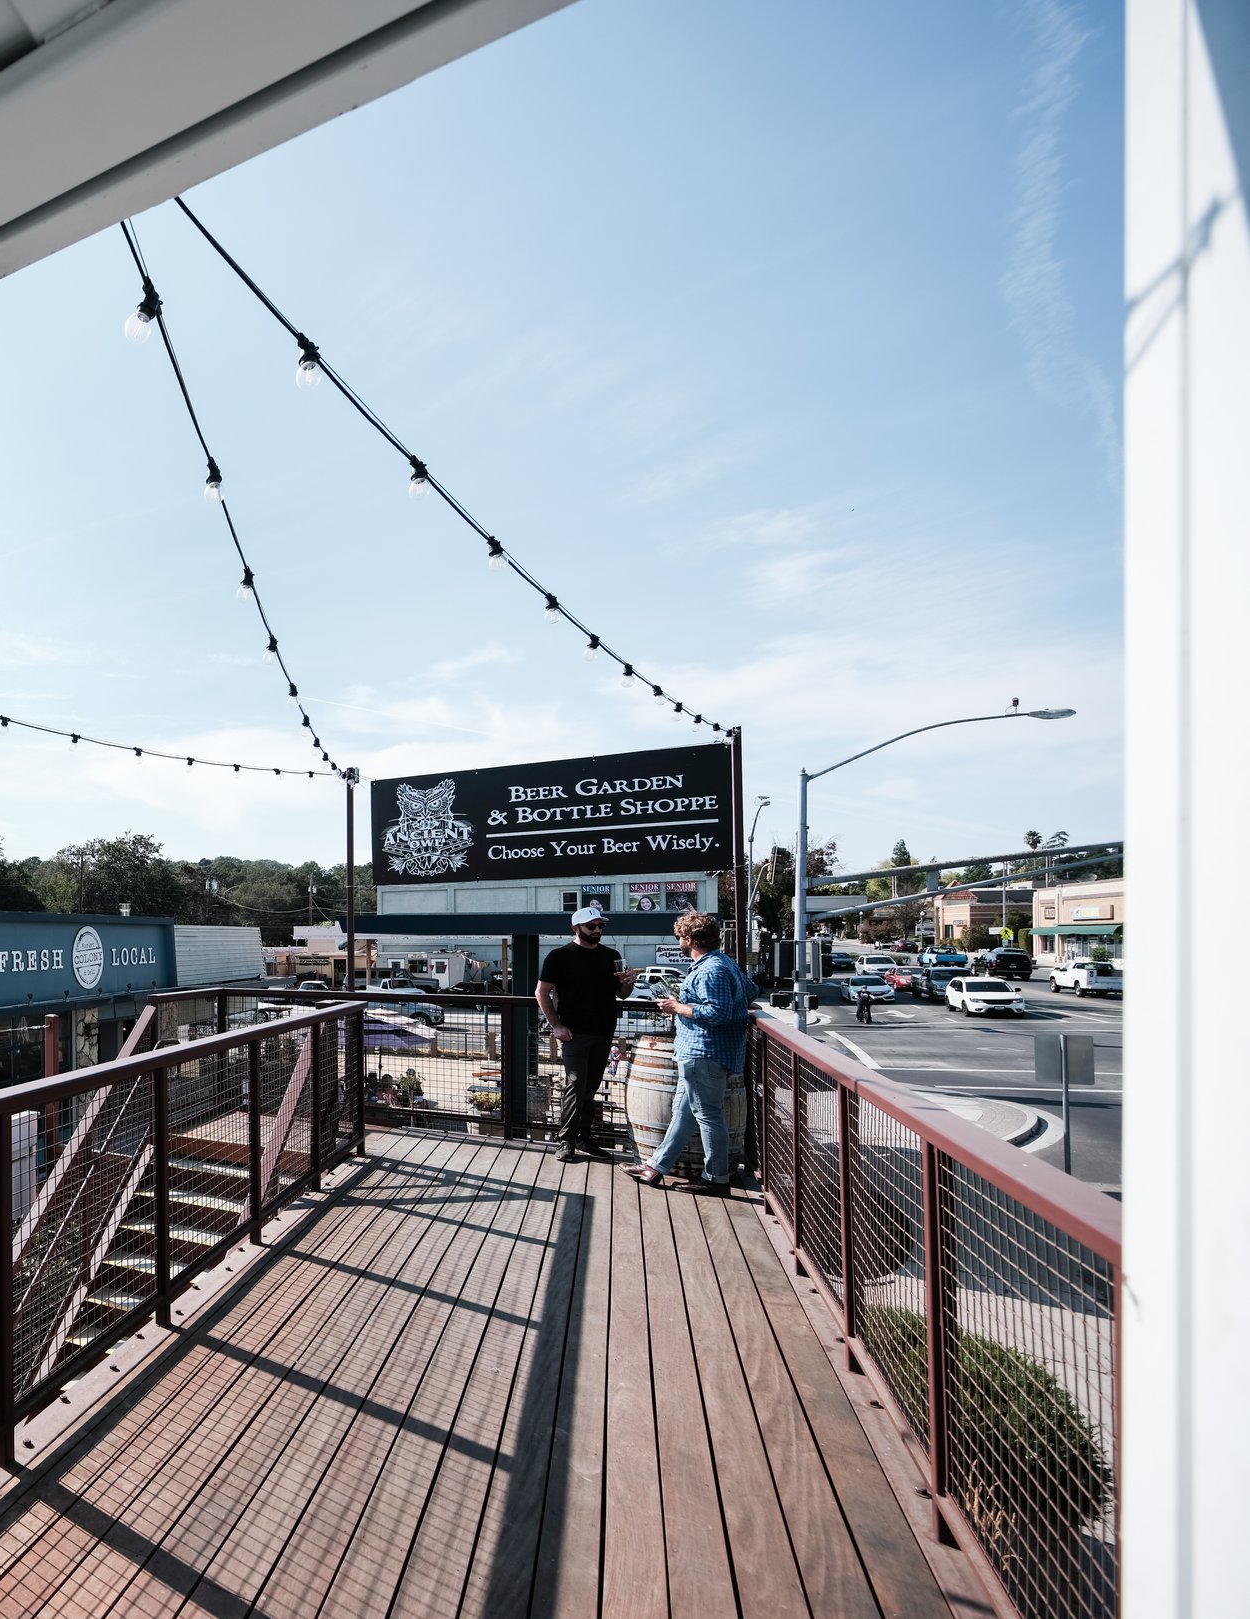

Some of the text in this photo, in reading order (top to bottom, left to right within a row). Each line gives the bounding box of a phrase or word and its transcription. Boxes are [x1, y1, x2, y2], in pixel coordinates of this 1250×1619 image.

[487, 809, 508, 826] &
[383, 826, 472, 847] ANCIENT
[409, 839, 445, 849] OWL
[487, 833, 720, 860] Choose Your Beer Wisely.
[582, 885, 610, 893] SENIOR
[630, 883, 659, 891] SENIOR
[666, 882, 697, 890] SENIOR
[74, 951, 103, 965] COLONY
[111, 947, 156, 966] LOCAL
